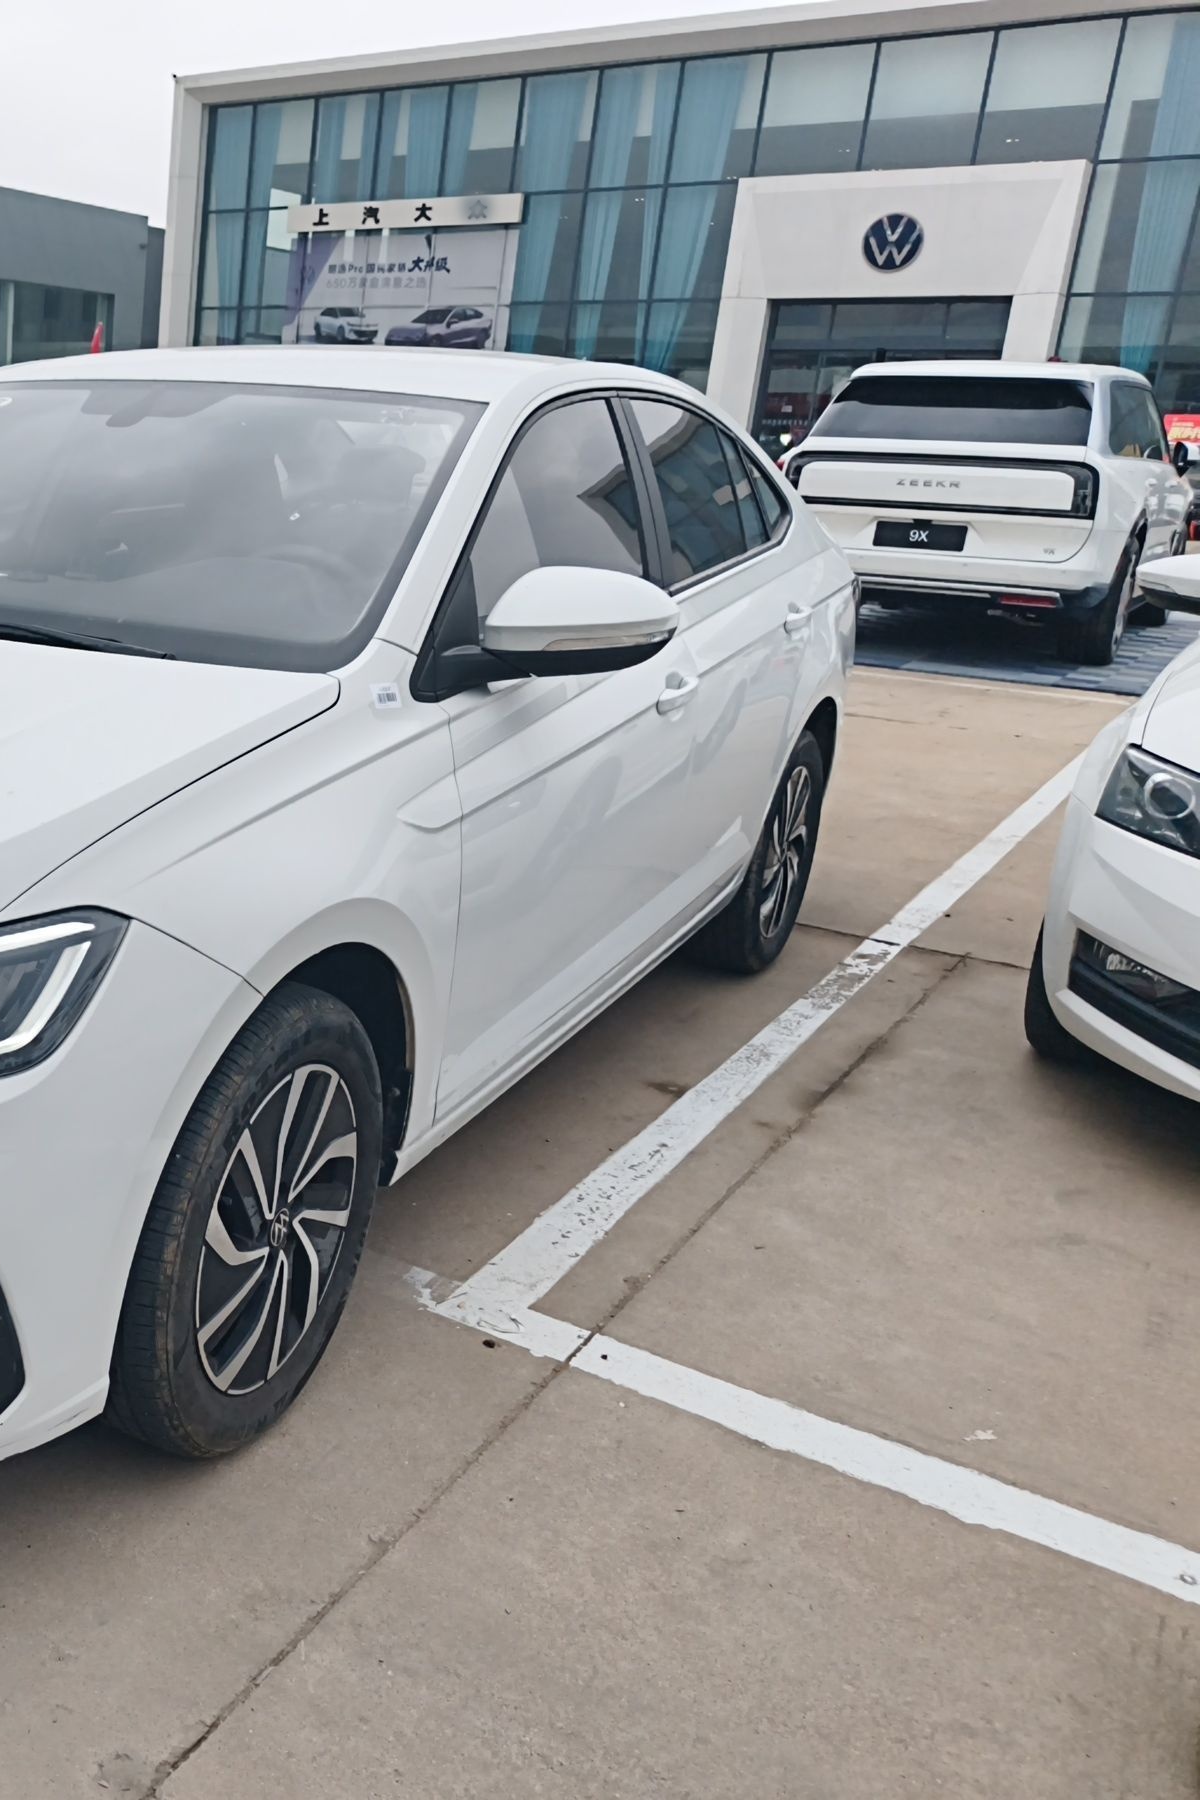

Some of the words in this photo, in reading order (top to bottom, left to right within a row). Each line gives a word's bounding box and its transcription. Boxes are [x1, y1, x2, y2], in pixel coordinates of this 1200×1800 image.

[864, 214, 922, 269] VW
[896, 478, 962, 489] ZEEKR
[909, 529, 929, 543] 9X
